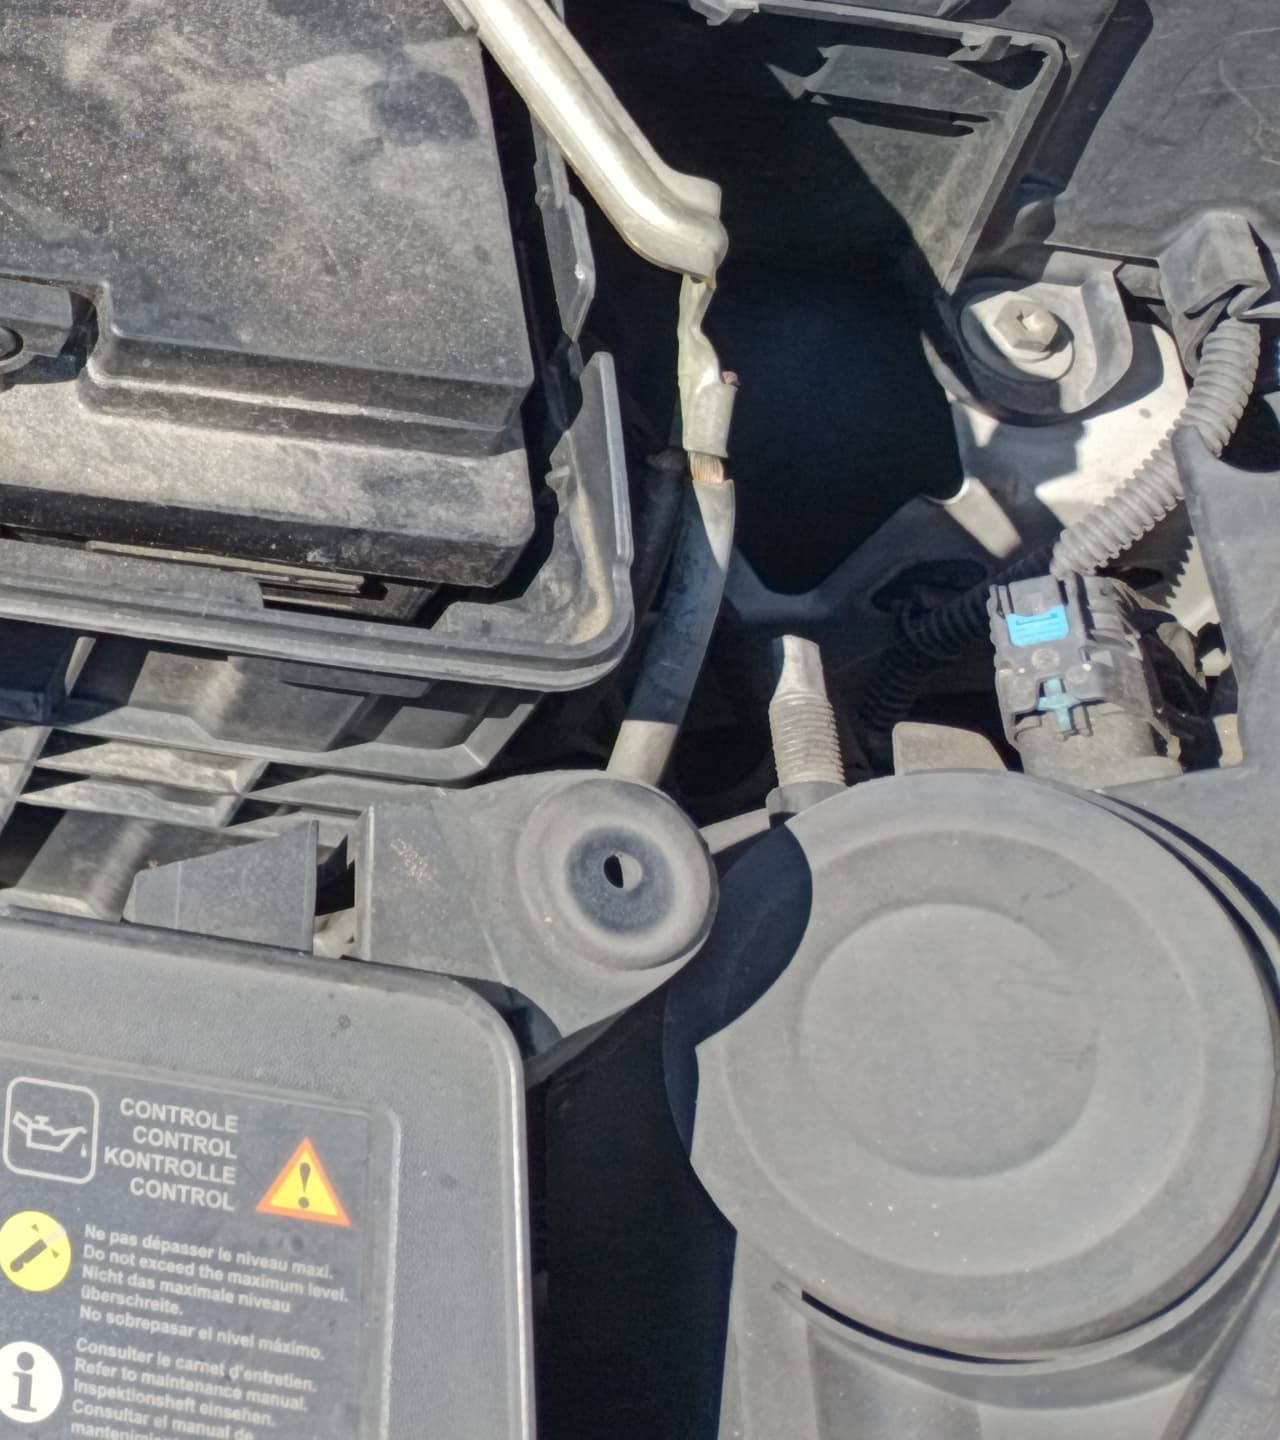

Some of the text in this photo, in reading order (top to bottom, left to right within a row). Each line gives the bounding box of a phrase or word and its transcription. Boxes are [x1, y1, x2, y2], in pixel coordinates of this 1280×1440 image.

[118, 1096, 238, 1134] CONTROLE
[131, 1124, 238, 1160] CONTROL
[102, 1144, 237, 1186] KONTROLLE
[128, 1175, 236, 1212] CONTROL
[83, 1222, 106, 1241] Ne
[108, 1230, 138, 1247] pas
[140, 1233, 215, 1259] dépasser
[216, 1245, 232, 1262] le
[235, 1250, 288, 1272] niveau
[81, 1263, 291, 1314] Nicht das maximale niveau
[82, 1242, 106, 1261] Do
[108, 1250, 136, 1267] not
[138, 1256, 195, 1276] exceed
[198, 1263, 224, 1282] the
[227, 1271, 304, 1295] maximum
